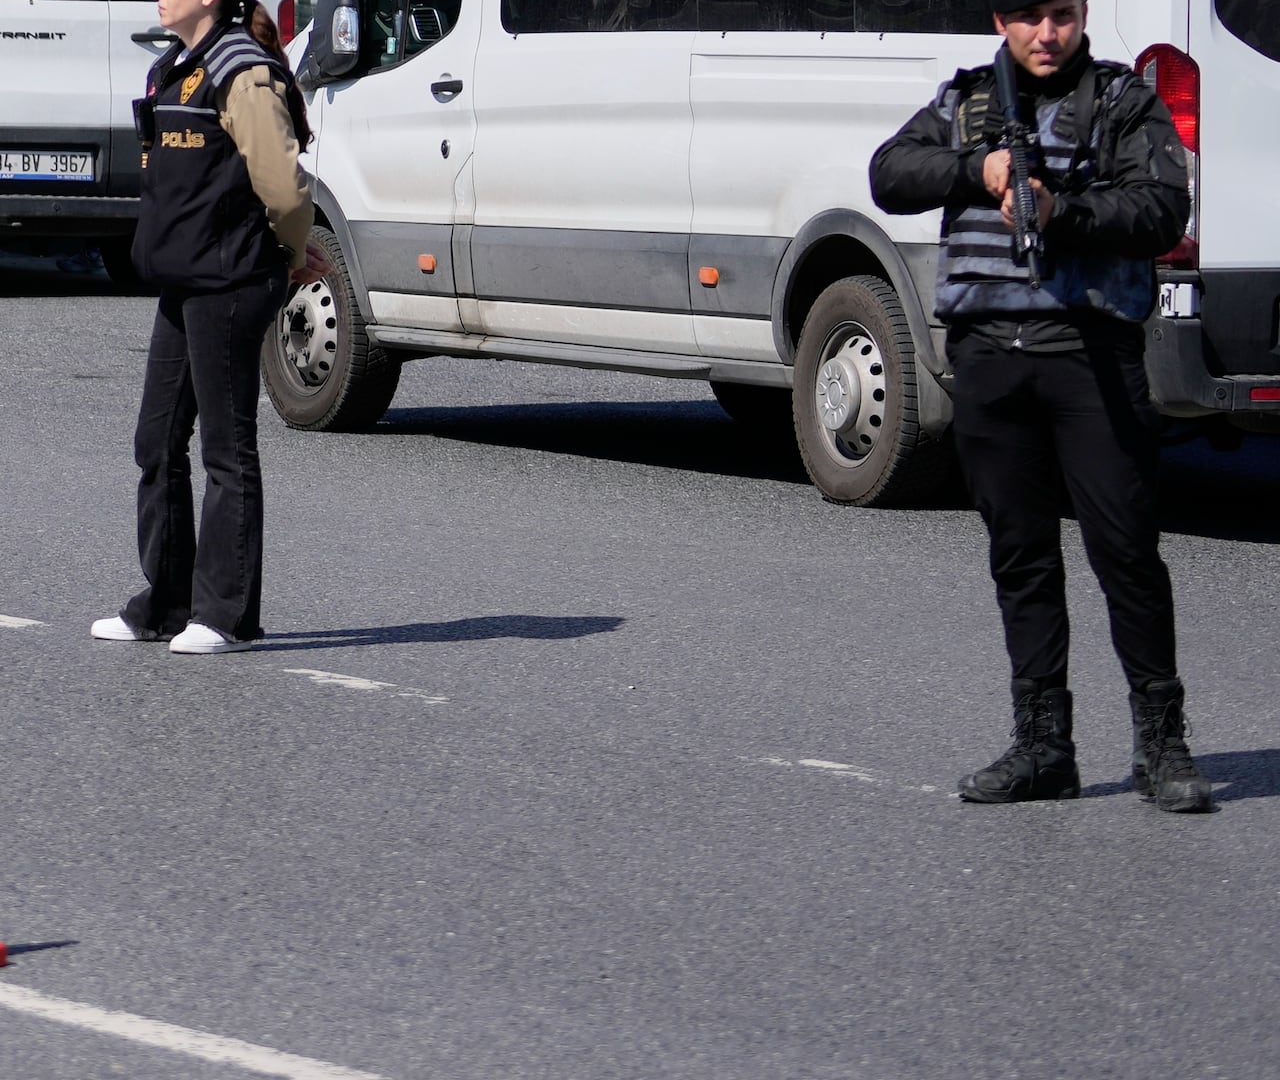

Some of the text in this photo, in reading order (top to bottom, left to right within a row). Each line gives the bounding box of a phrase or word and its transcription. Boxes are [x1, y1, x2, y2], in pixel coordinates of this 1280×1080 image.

[161, 128, 206, 148] POLİS
[22, 153, 40, 172] BV
[50, 154, 88, 173] 3967
